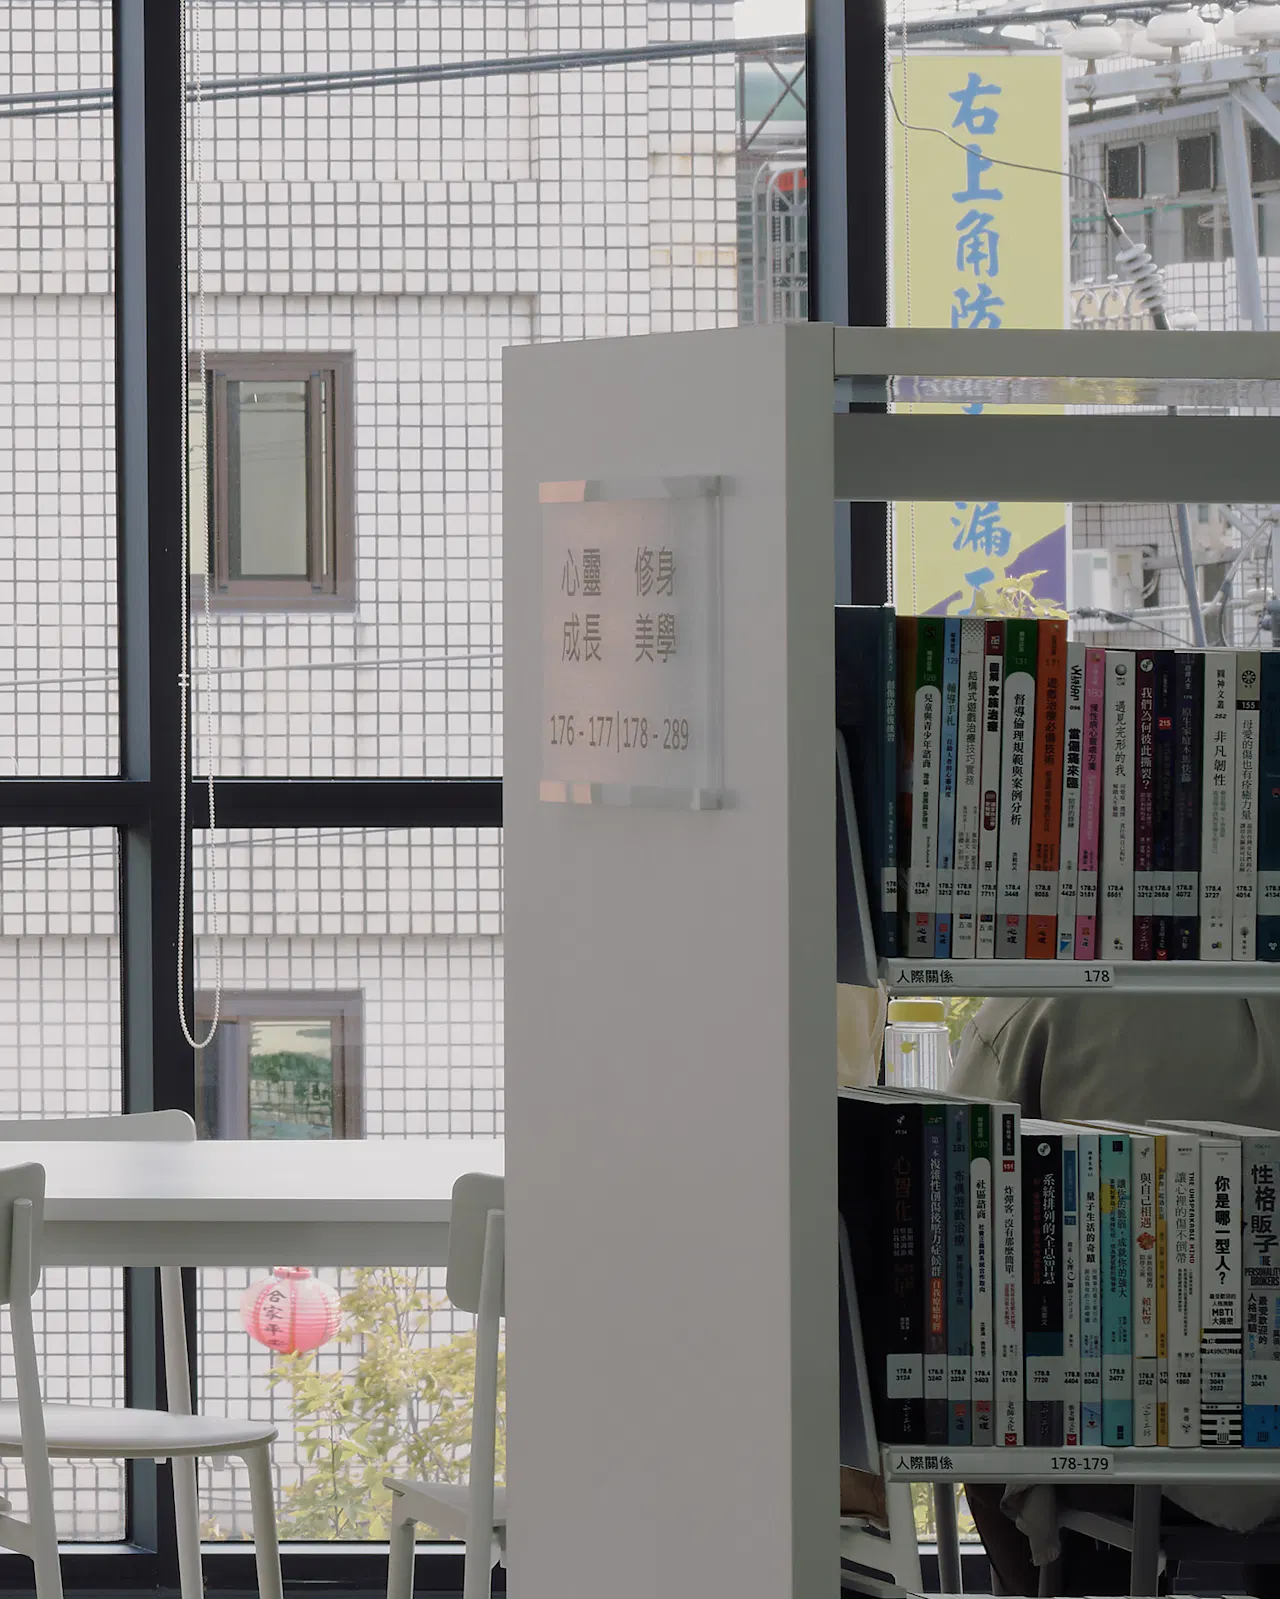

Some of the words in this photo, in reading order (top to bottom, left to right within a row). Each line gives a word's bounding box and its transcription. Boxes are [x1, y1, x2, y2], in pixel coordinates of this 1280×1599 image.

[561, 547, 602, 597] 心靈
[634, 546, 677, 597] 修身
[561, 614, 602, 663] 成長
[634, 613, 677, 663] 美學
[550, 714, 574, 746] 176
[588, 715, 613, 747] 177
[623, 717, 648, 749] 178
[663, 718, 689, 750] 289
[897, 969, 954, 984] 人際關係
[1084, 970, 1110, 982] 178
[976, 1179, 986, 1220] 社區諮商
[1140, 1172, 1152, 1229] 與自己相遇
[1251, 1163, 1278, 1253] 性格販子
[1215, 1176, 1231, 1285] 你是哪一型人？
[1212, 1308, 1233, 1316] MBTI
[896, 1455, 954, 1470] 人際關係
[1051, 1457, 1109, 1470] 178-179
